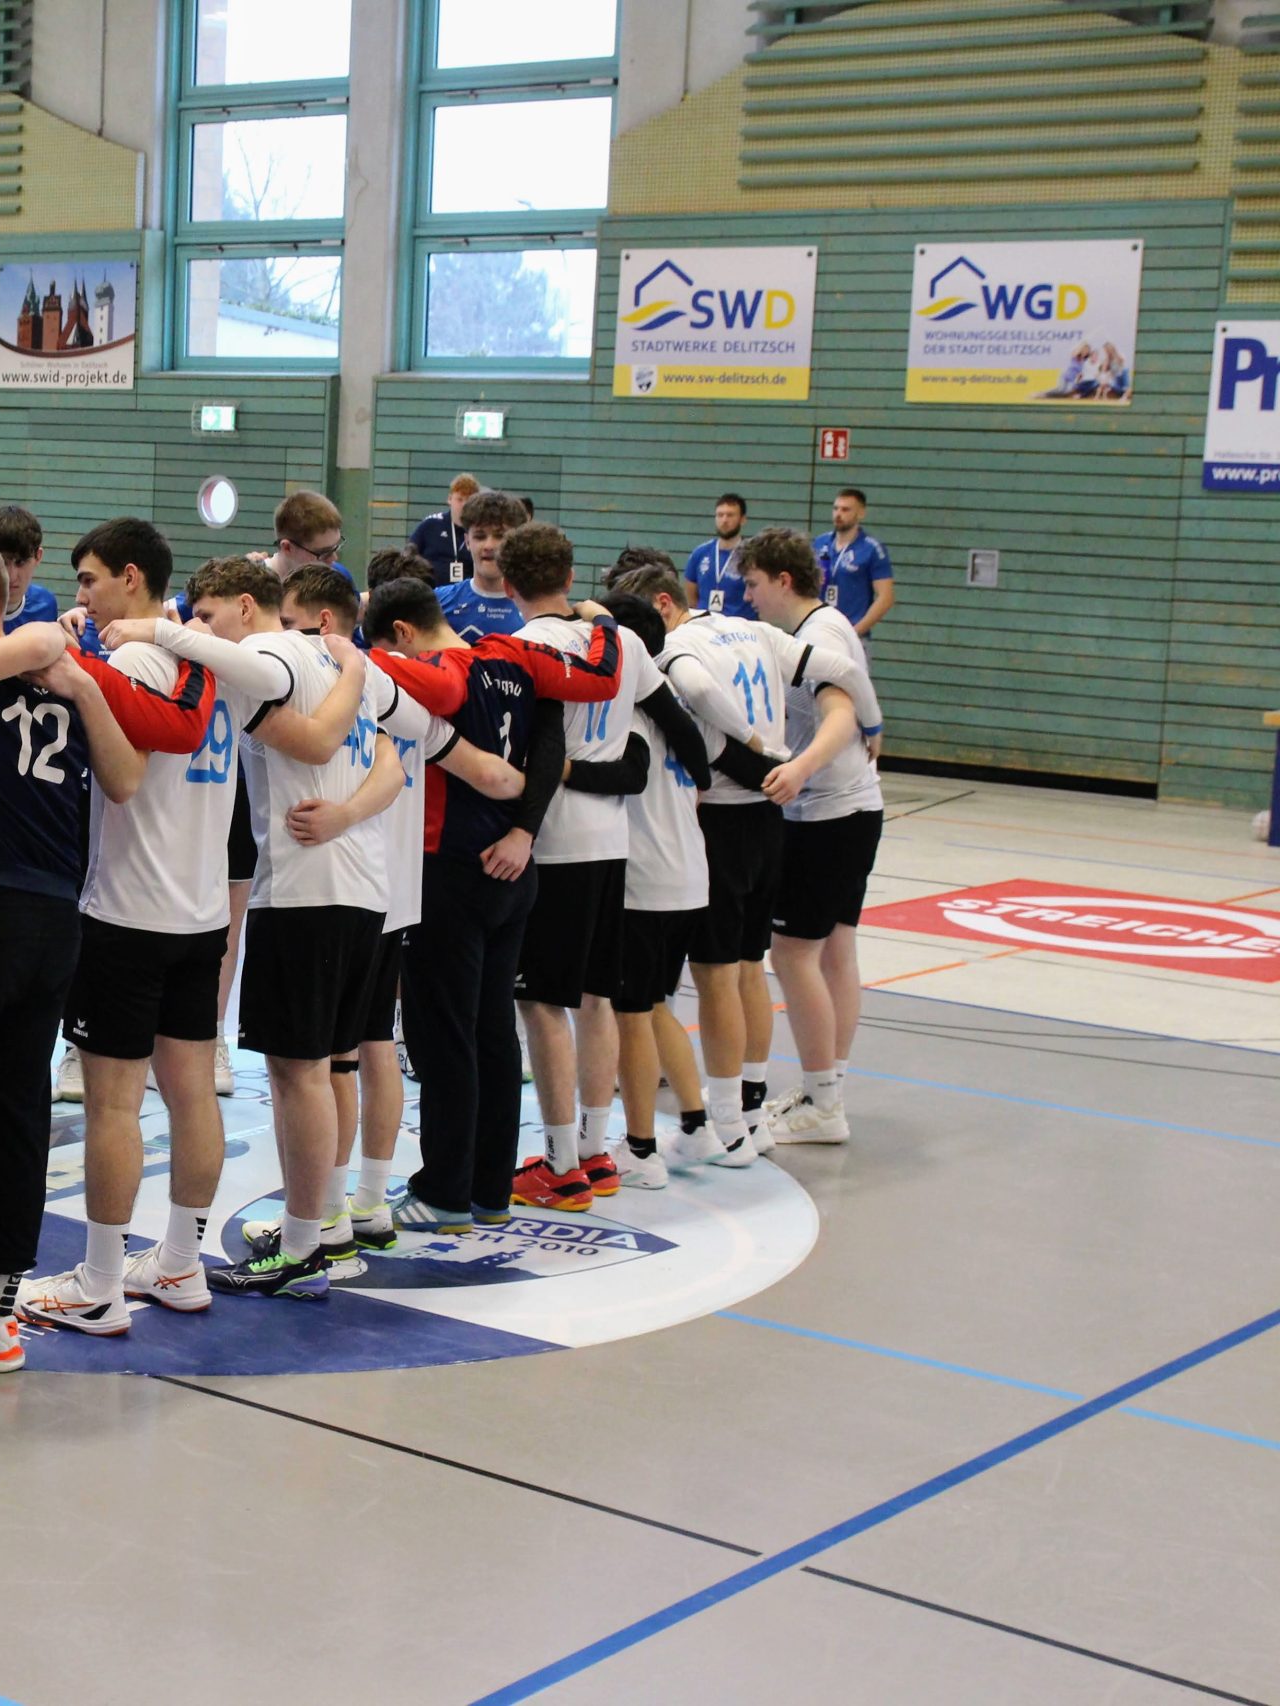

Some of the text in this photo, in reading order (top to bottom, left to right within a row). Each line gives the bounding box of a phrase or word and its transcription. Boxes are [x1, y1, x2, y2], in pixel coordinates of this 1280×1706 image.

[690, 289, 796, 329] SWD
[981, 284, 1087, 320] WGD
[924, 330, 1083, 341] WOHNUNGSGESELLSCHAFT
[631, 340, 796, 354] STADTWERKE DELITZSCH
[923, 344, 1052, 355] DER STADT DELITZSCH
[1, 370, 128, 387] www.swid-projekt.de
[663, 372, 788, 385] www.sw-delitzsch.de
[921, 373, 1028, 384] www.wg-delitzsch.de
[452, 565, 462, 578] E
[711, 594, 721, 607] A
[827, 588, 836, 600] B
[733, 656, 773, 725] 11
[1, 695, 70, 784] 12
[937, 898, 1280, 954] STREICHE
[523, 1239, 600, 1256] 2010
